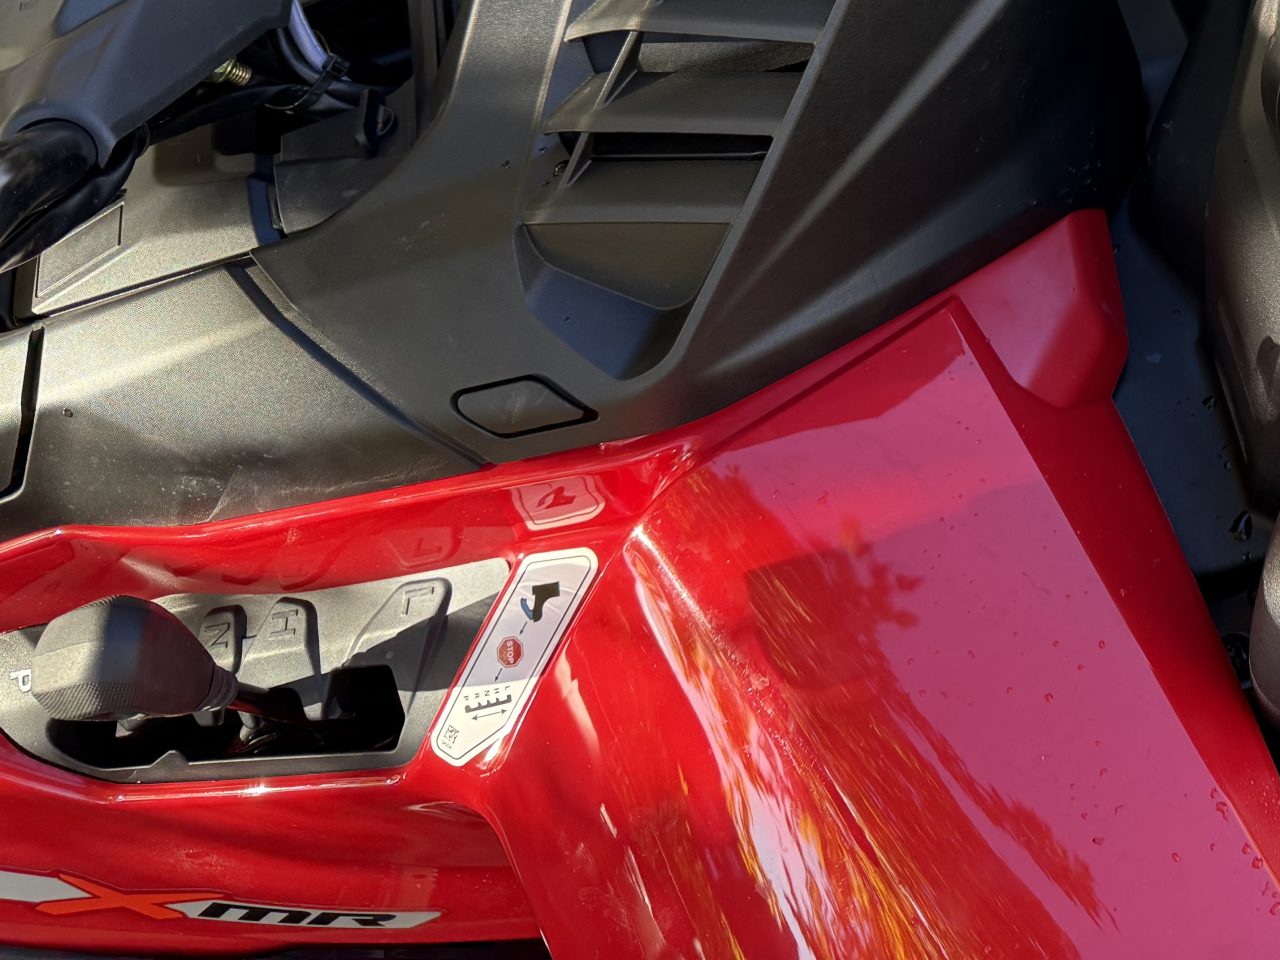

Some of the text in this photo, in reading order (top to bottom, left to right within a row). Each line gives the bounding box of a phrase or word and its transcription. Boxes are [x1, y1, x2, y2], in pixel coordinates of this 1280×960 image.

[402, 585, 436, 617] L
[203, 621, 232, 651] N
[269, 608, 300, 638] H
[506, 640, 515, 664] STOP
[9, 669, 32, 693] P
